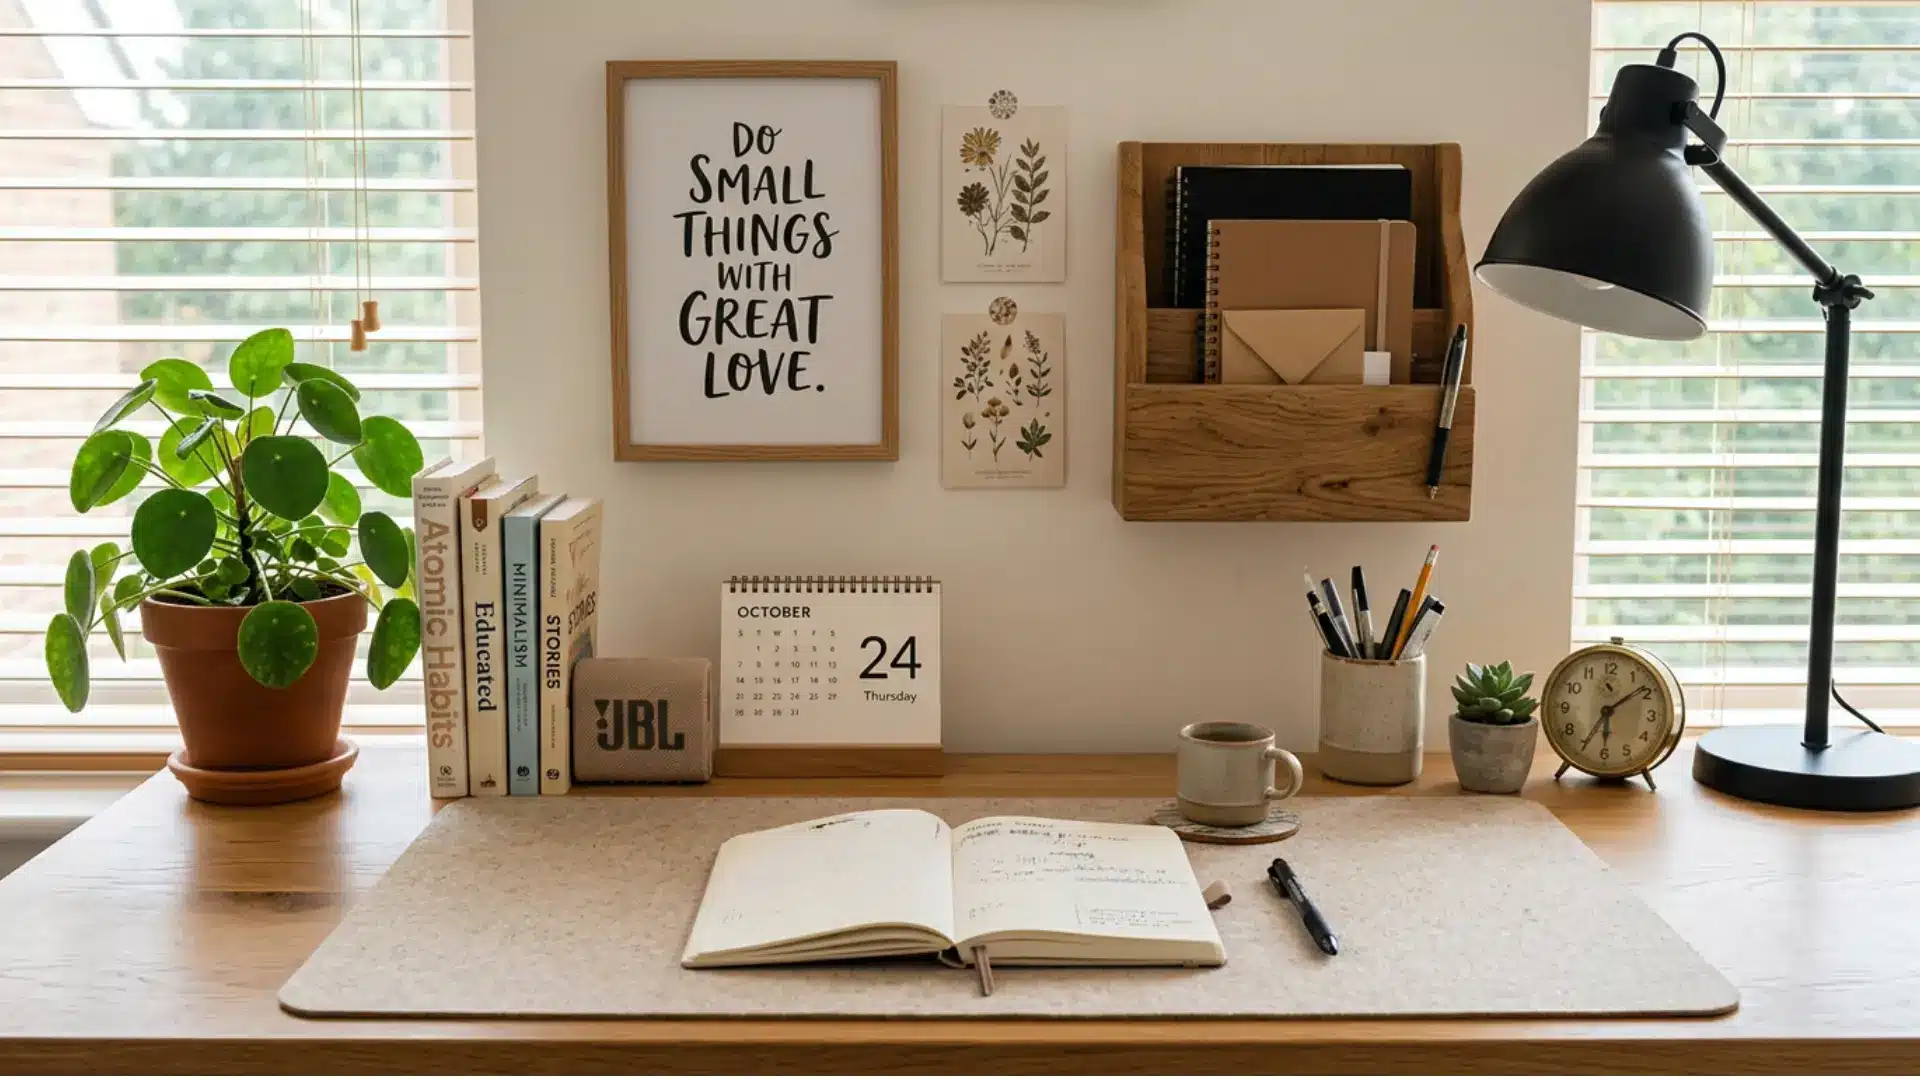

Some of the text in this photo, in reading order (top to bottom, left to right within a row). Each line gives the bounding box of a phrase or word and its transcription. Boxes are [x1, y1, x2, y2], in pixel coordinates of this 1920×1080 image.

[733, 121, 783, 158] DO
[689, 153, 826, 206] SMALL
[672, 210, 840, 260] THINGS
[717, 261, 791, 292] WITH
[678, 290, 834, 346] GREAT
[704, 348, 825, 399] LOVE.
[421, 516, 455, 637] Atomic
[512, 562, 528, 668] MINIMALISM
[737, 605, 812, 619] OCTOBER
[474, 601, 498, 713] Educated
[546, 614, 561, 689] STORIES
[858, 635, 923, 680] 24
[790, 660, 801, 669] 10
[1605, 663, 1617, 675] 12
[1584, 667, 1593, 679] 11
[1630, 670, 1635, 683] 1
[1567, 682, 1581, 694] 10
[427, 645, 459, 749] Habits
[863, 690, 918, 705] Thursday
[1560, 701, 1570, 713] 9
[1647, 710, 1656, 722] 3
[1565, 723, 1574, 735] 8
[1638, 731, 1648, 742] 4
[1600, 748, 1609, 760] 6
[1622, 744, 1631, 756] 5
